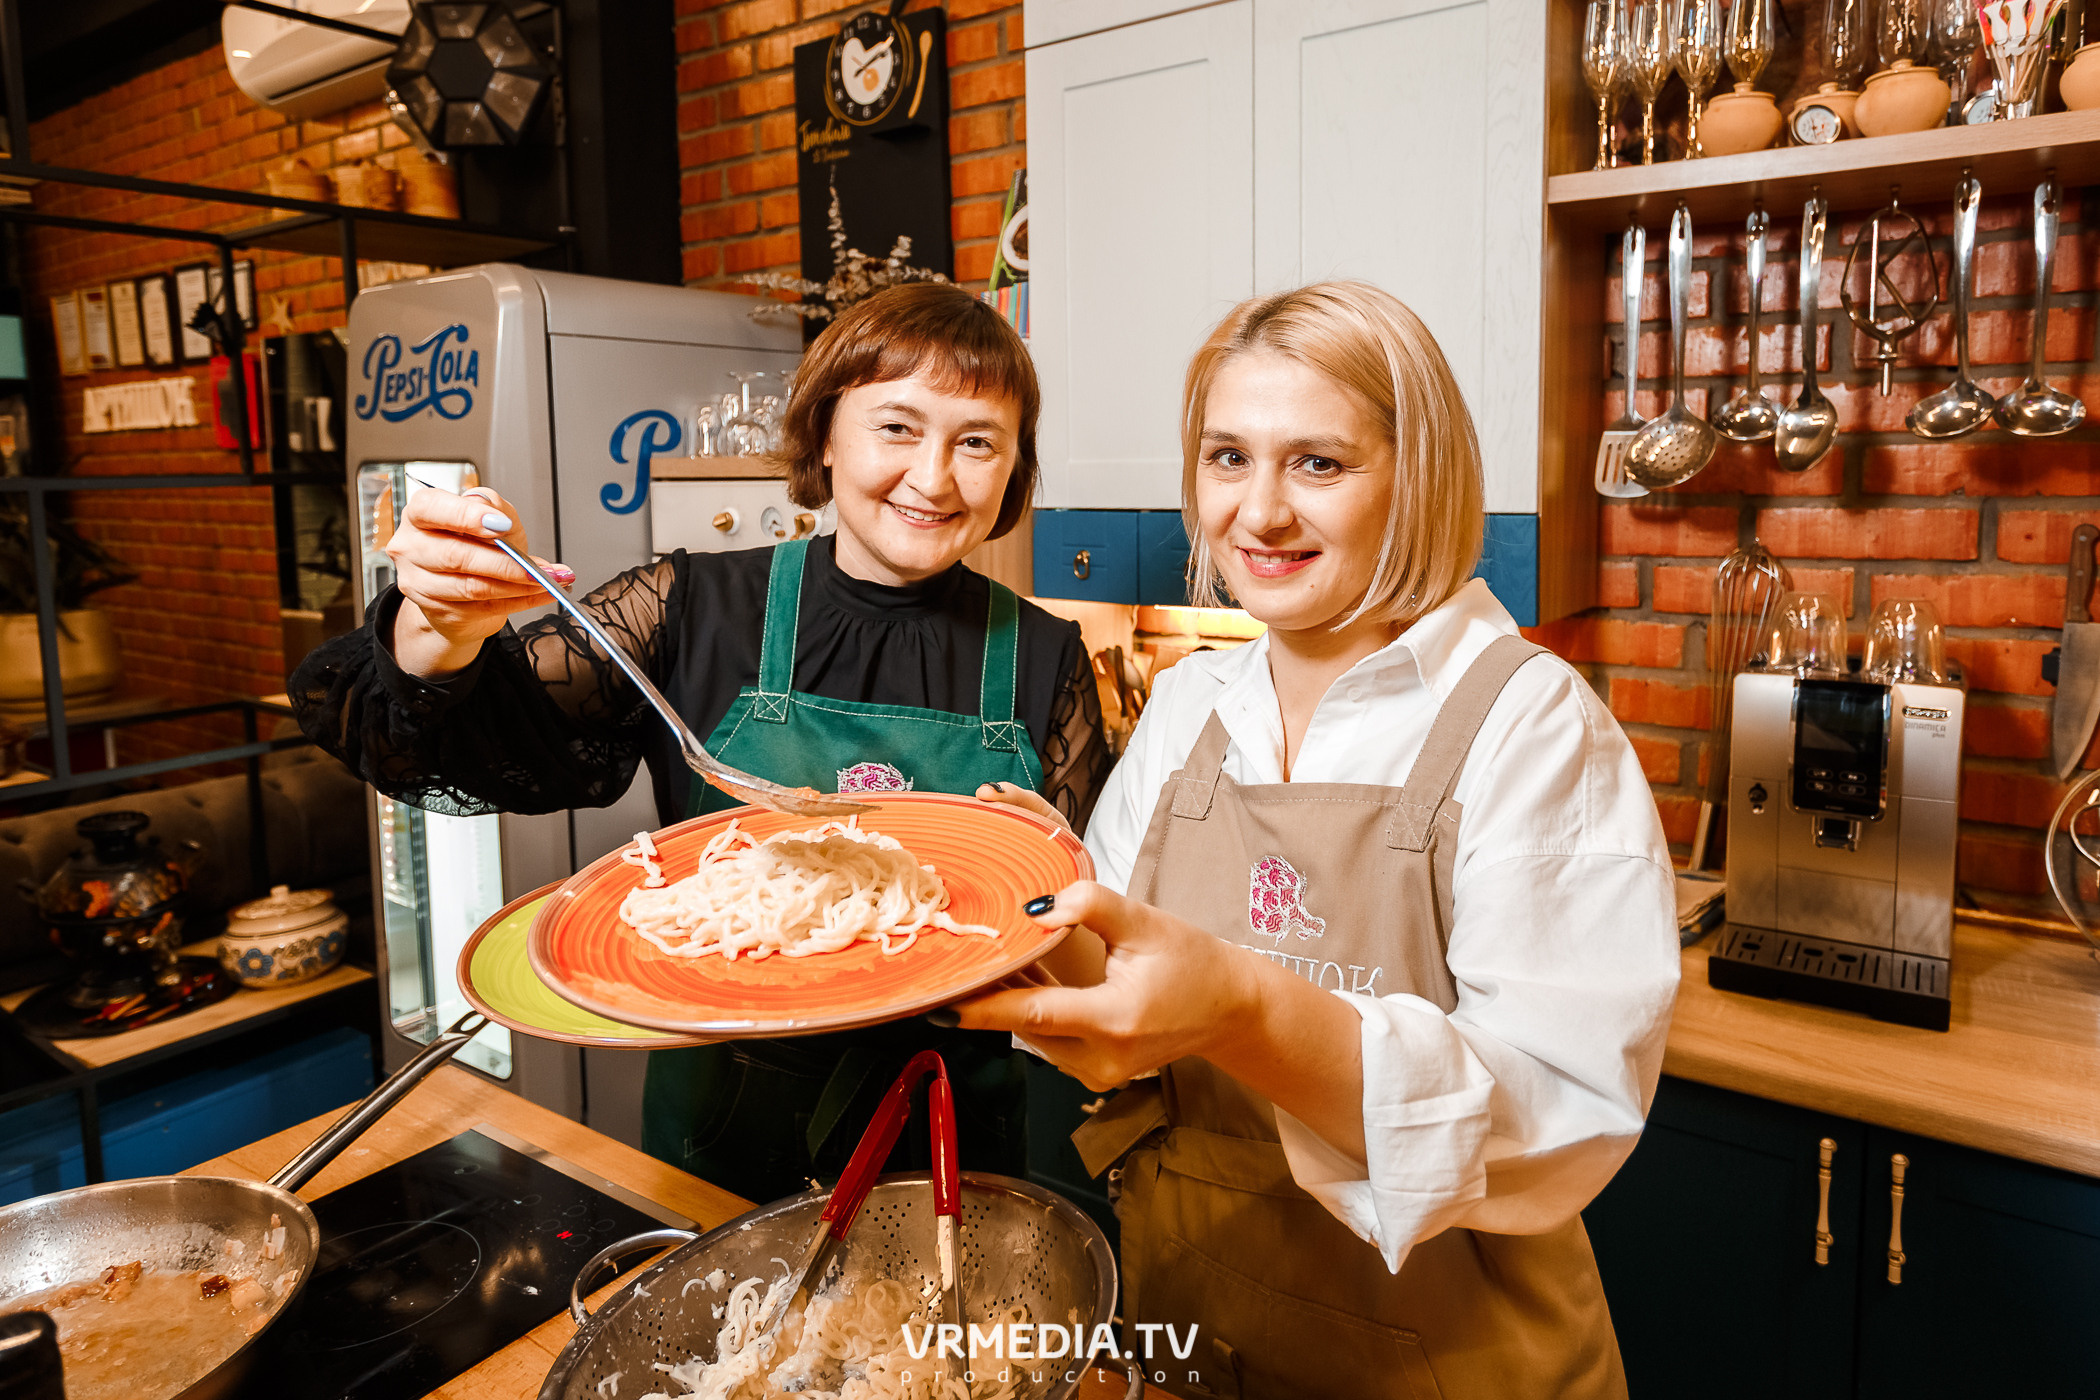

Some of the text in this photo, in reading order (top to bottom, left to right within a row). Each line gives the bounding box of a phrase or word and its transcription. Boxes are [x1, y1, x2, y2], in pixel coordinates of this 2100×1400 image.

[857, 15, 870, 30] 12
[846, 101, 855, 115] 7
[862, 105, 871, 119] 6
[600, 409, 682, 515] P
